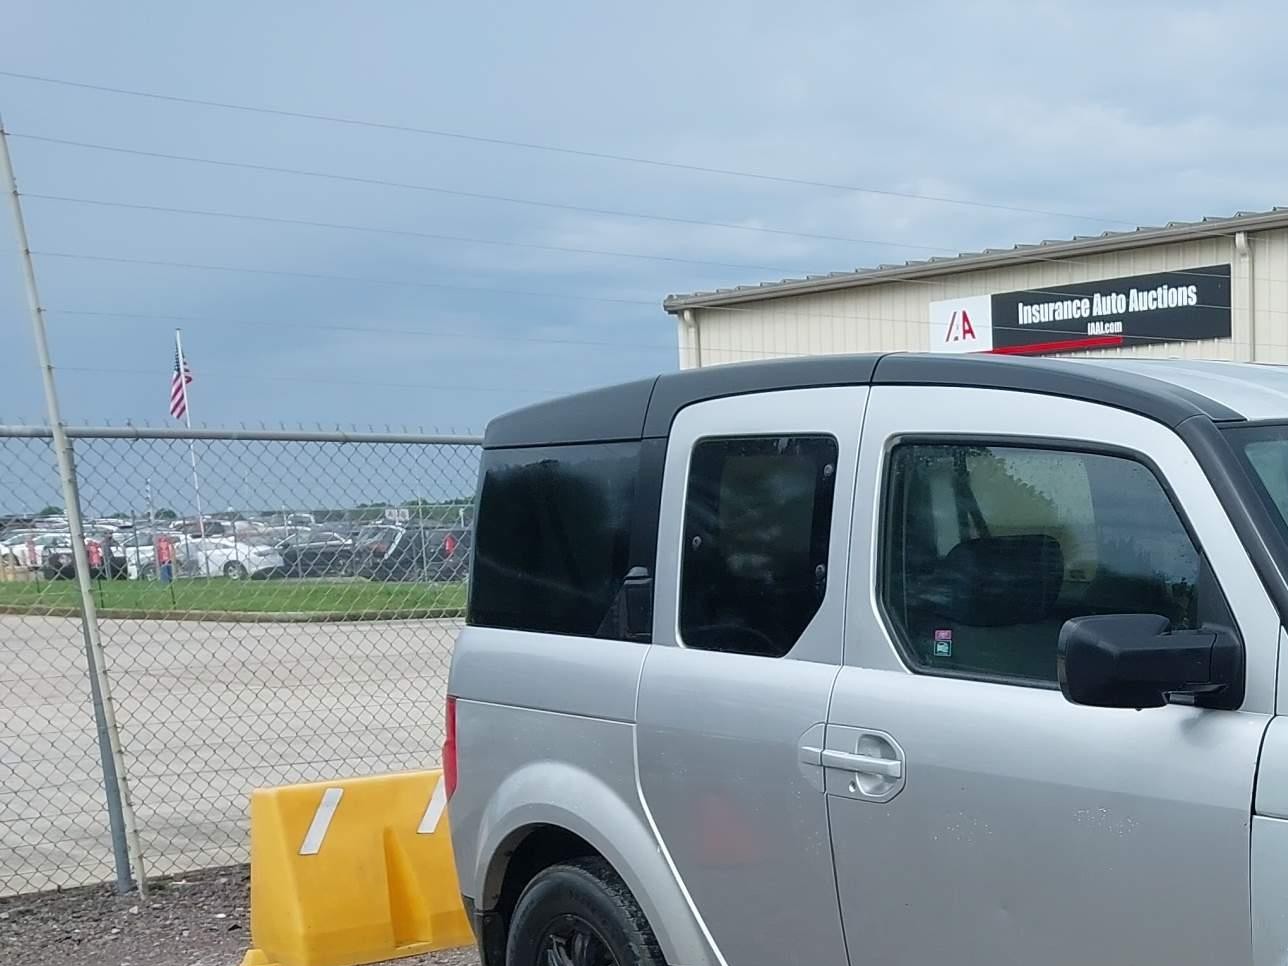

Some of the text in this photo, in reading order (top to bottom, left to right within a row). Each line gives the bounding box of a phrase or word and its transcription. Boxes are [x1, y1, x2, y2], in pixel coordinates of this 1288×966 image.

[1018, 285, 1197, 325] Insurance Auto Auctions
[1087, 321, 1123, 336] IAAI.com
